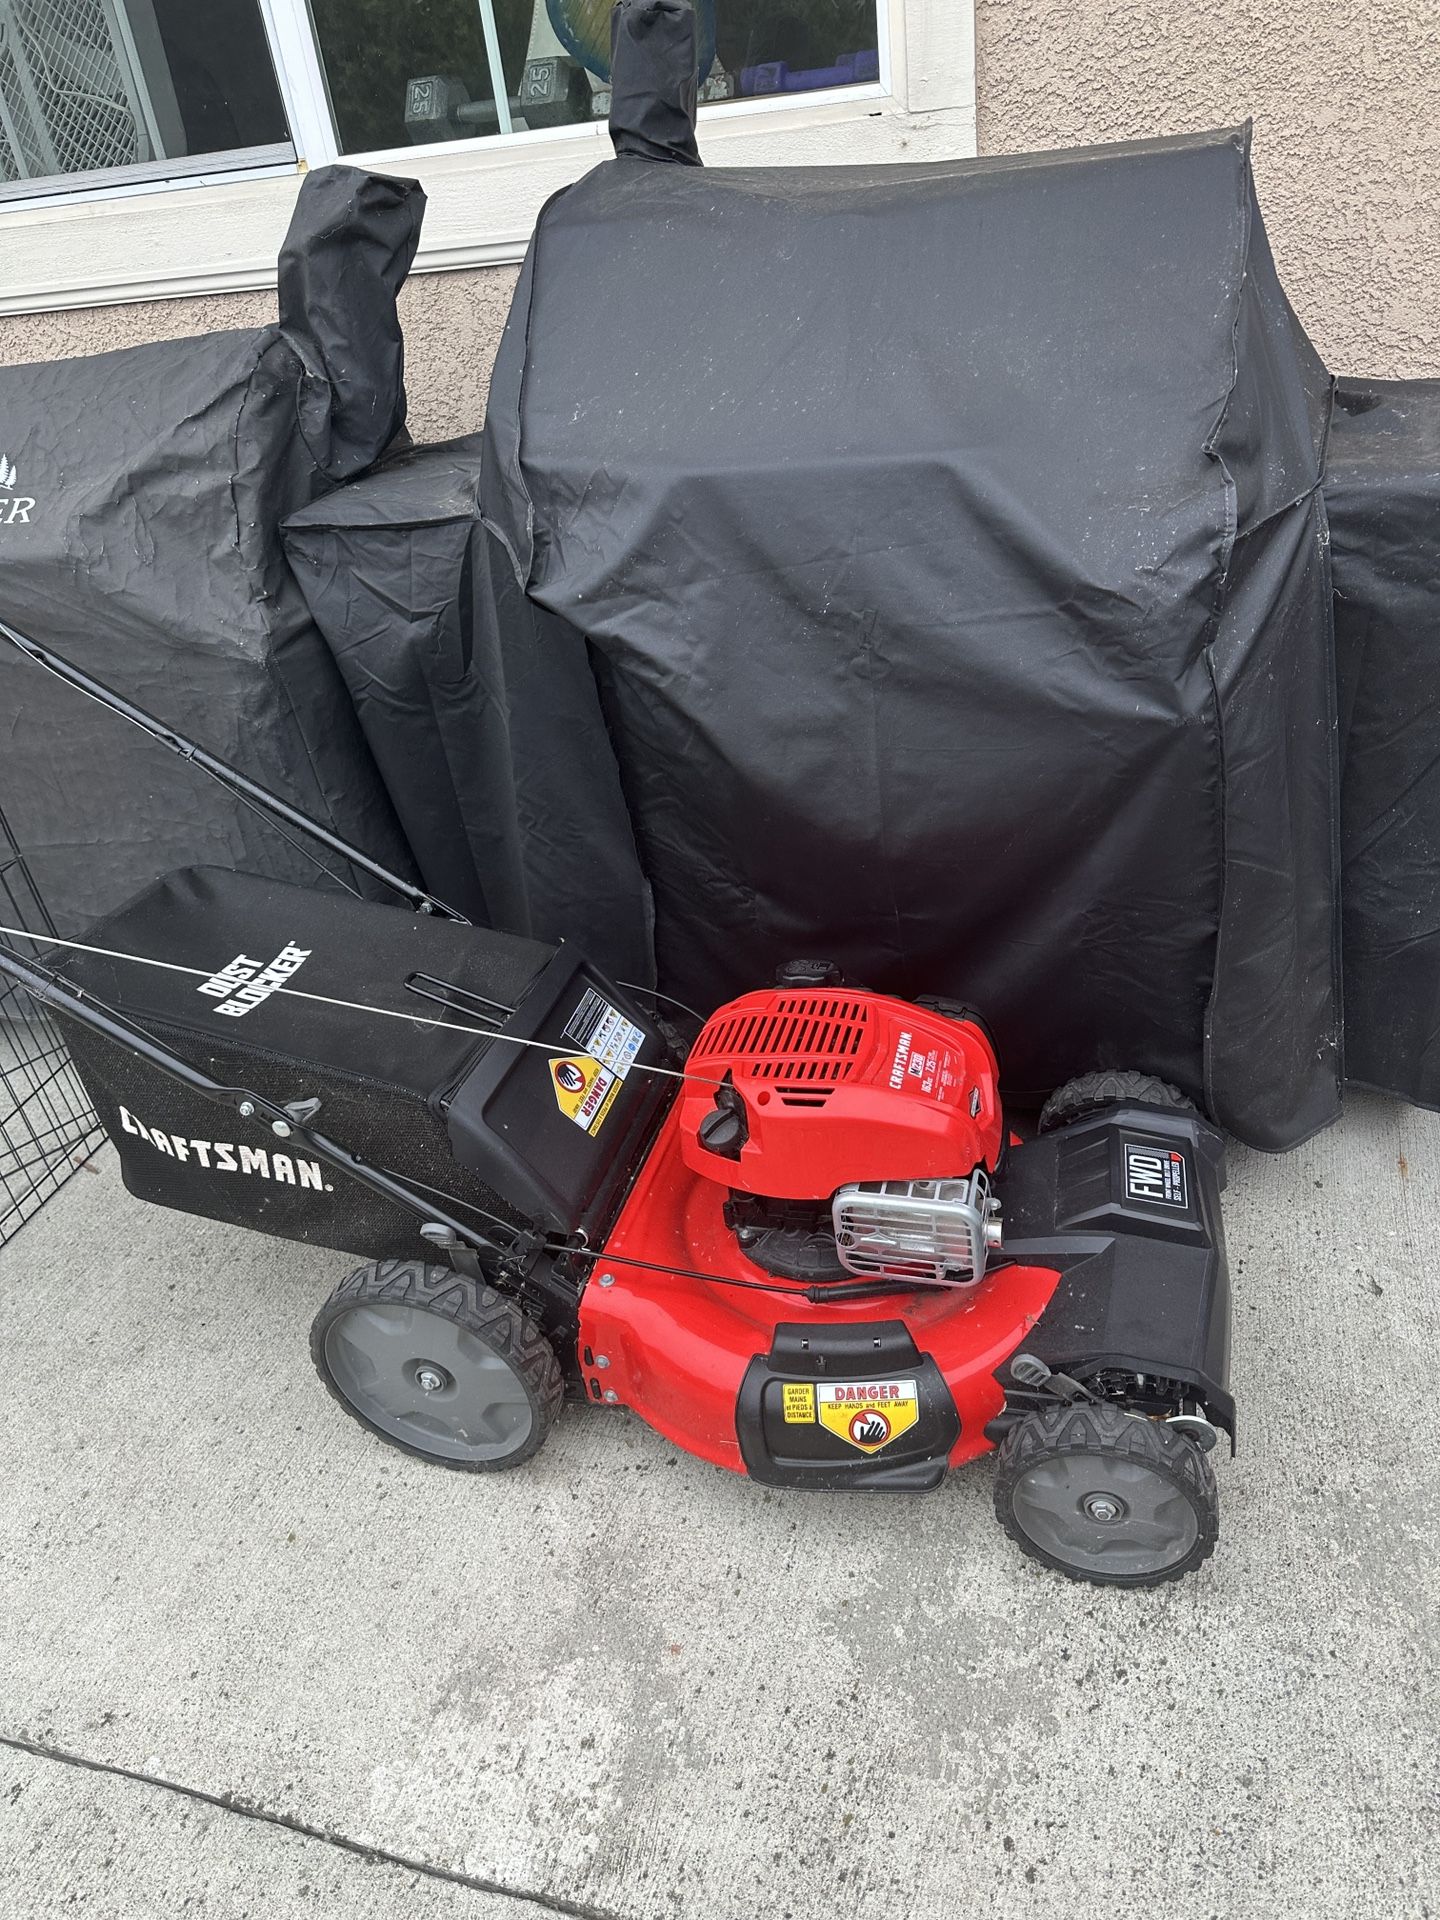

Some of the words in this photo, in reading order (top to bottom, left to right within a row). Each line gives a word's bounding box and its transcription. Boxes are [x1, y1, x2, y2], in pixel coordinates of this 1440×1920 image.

[413, 85, 430, 113] 25
[530, 67, 549, 96] 25
[196, 953, 264, 998] DUST
[212, 945, 312, 1017] BLOCKER
[889, 1031, 912, 1090] CRAFTSMAN
[581, 1077, 607, 1117] DANGER
[1129, 1155, 1163, 1198] FWD
[835, 1385, 900, 1400] DANGER
